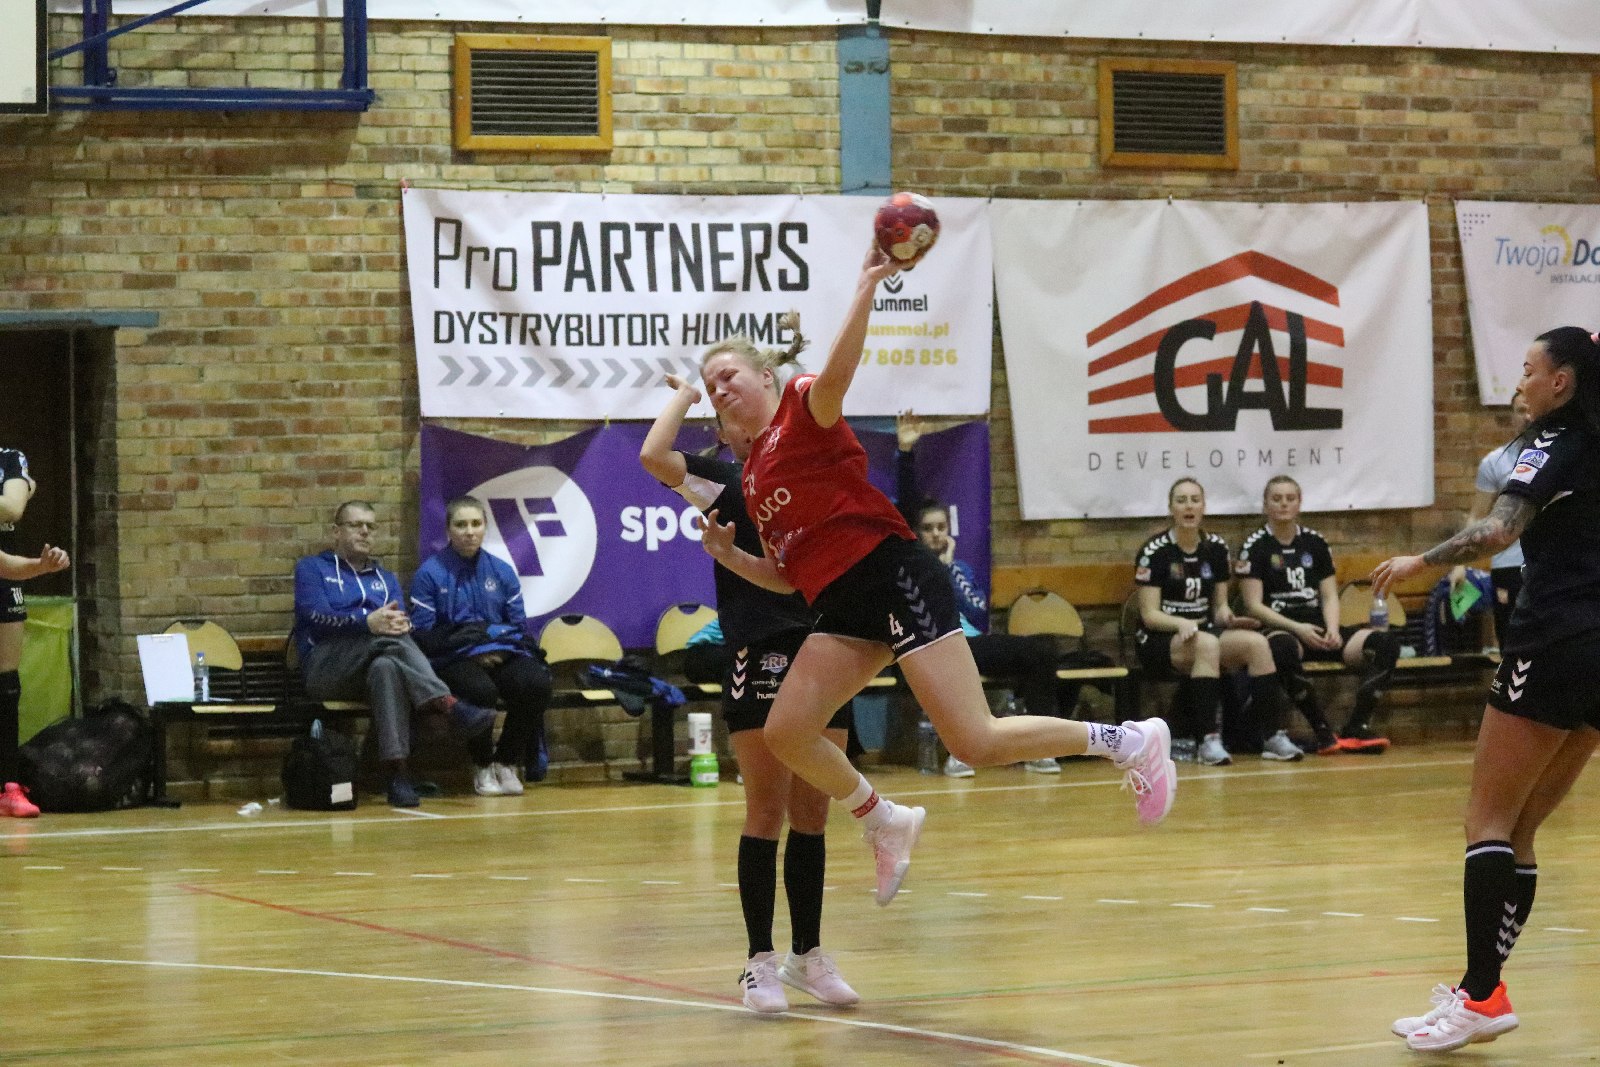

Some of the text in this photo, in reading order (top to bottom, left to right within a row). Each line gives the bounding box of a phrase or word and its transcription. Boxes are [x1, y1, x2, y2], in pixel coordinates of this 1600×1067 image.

[433, 217, 810, 292] Pro PARTNERS
[1495, 237, 1559, 274] Twoja
[871, 294, 928, 312] ummel
[433, 310, 811, 347] DYSTRYBUTOR HUMME
[866, 321, 950, 339] ummel.pl
[877, 348, 915, 366] 805
[919, 348, 958, 366] 856
[1154, 300, 1343, 432] GAL
[1088, 447, 1344, 471] DEVELOPMENT
[620, 505, 705, 551] spo
[888, 612, 904, 636] 4
